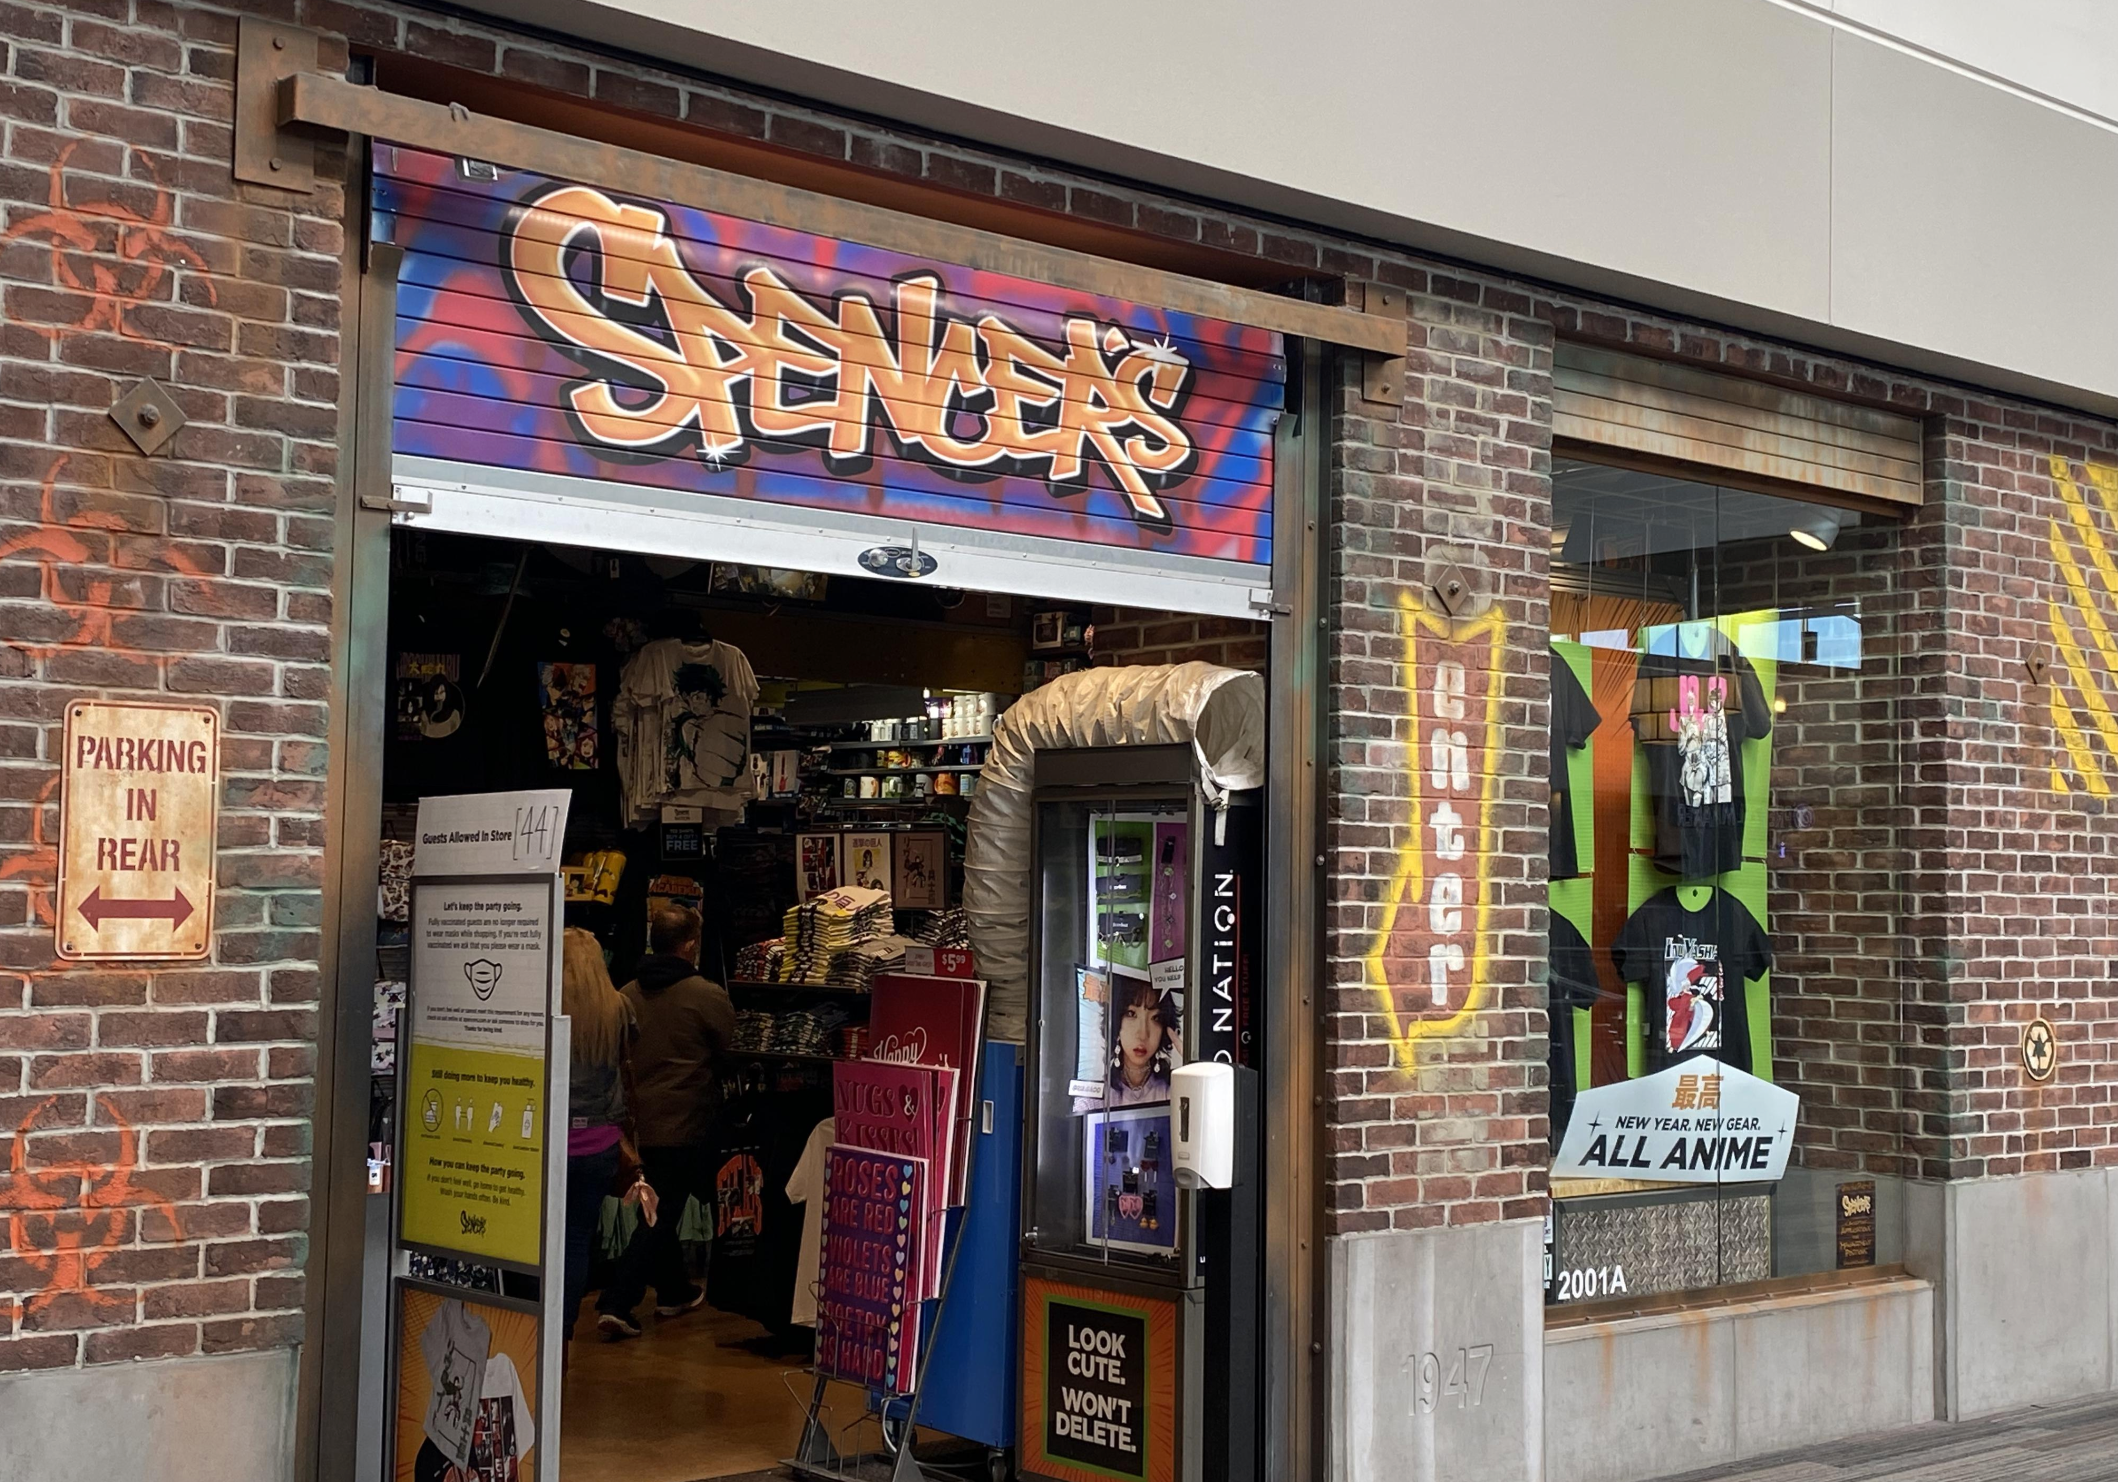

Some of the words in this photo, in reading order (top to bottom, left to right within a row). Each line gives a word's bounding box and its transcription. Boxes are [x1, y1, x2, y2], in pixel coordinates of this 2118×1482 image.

[76, 735, 206, 774] PARKING
[126, 788, 157, 821] IN
[97, 838, 180, 872] REAR
[422, 832, 447, 844] Guests
[449, 830, 479, 844] Allowed
[481, 830, 489, 842] In
[490, 830, 512, 842] Store
[666, 840, 698, 851] FREE
[443, 902, 458, 911] Let's
[459, 901, 473, 912] keep
[474, 901, 484, 911] the
[485, 902, 501, 912] party
[503, 901, 522, 912] going.
[444, 1070, 460, 1082] doing
[461, 1073, 476, 1082] more
[476, 1073, 483, 1083] to
[484, 1074, 498, 1085] keep
[499, 1076, 511, 1086] you
[1671, 1074, 1724, 1110] 最高
[836, 1081, 896, 1118] NUGS
[903, 1094, 917, 1116] &
[1615, 1116, 1651, 1130] NEW
[1654, 1118, 1691, 1132] YEAR.
[1694, 1118, 1725, 1132] NEW
[1726, 1117, 1761, 1131] GEAR.
[443, 1160, 454, 1169] you
[454, 1161, 465, 1170] can
[466, 1161, 480, 1173] keep
[480, 1163, 490, 1173] the
[490, 1165, 506, 1178] party
[1578, 1134, 1651, 1169] ALL
[1659, 1136, 1773, 1170] ANIME
[832, 1156, 898, 1202] ROSES
[830, 1195, 858, 1228] ARE
[864, 1201, 894, 1236] RED
[828, 1234, 892, 1276] VIOLETS
[827, 1265, 851, 1294] ARE
[854, 1271, 890, 1305] BLUE
[1558, 1264, 1627, 1300] 2001A
[824, 1301, 888, 1345] POETRY
[1068, 1324, 1126, 1358] LOOK
[822, 1333, 835, 1366] IS
[841, 1339, 884, 1381] HARD
[1067, 1351, 1126, 1385] CUTE.
[1400, 1343, 1494, 1417] 1947
[1061, 1386, 1132, 1424] WON'T
[1056, 1411, 1137, 1453] DELETE.
